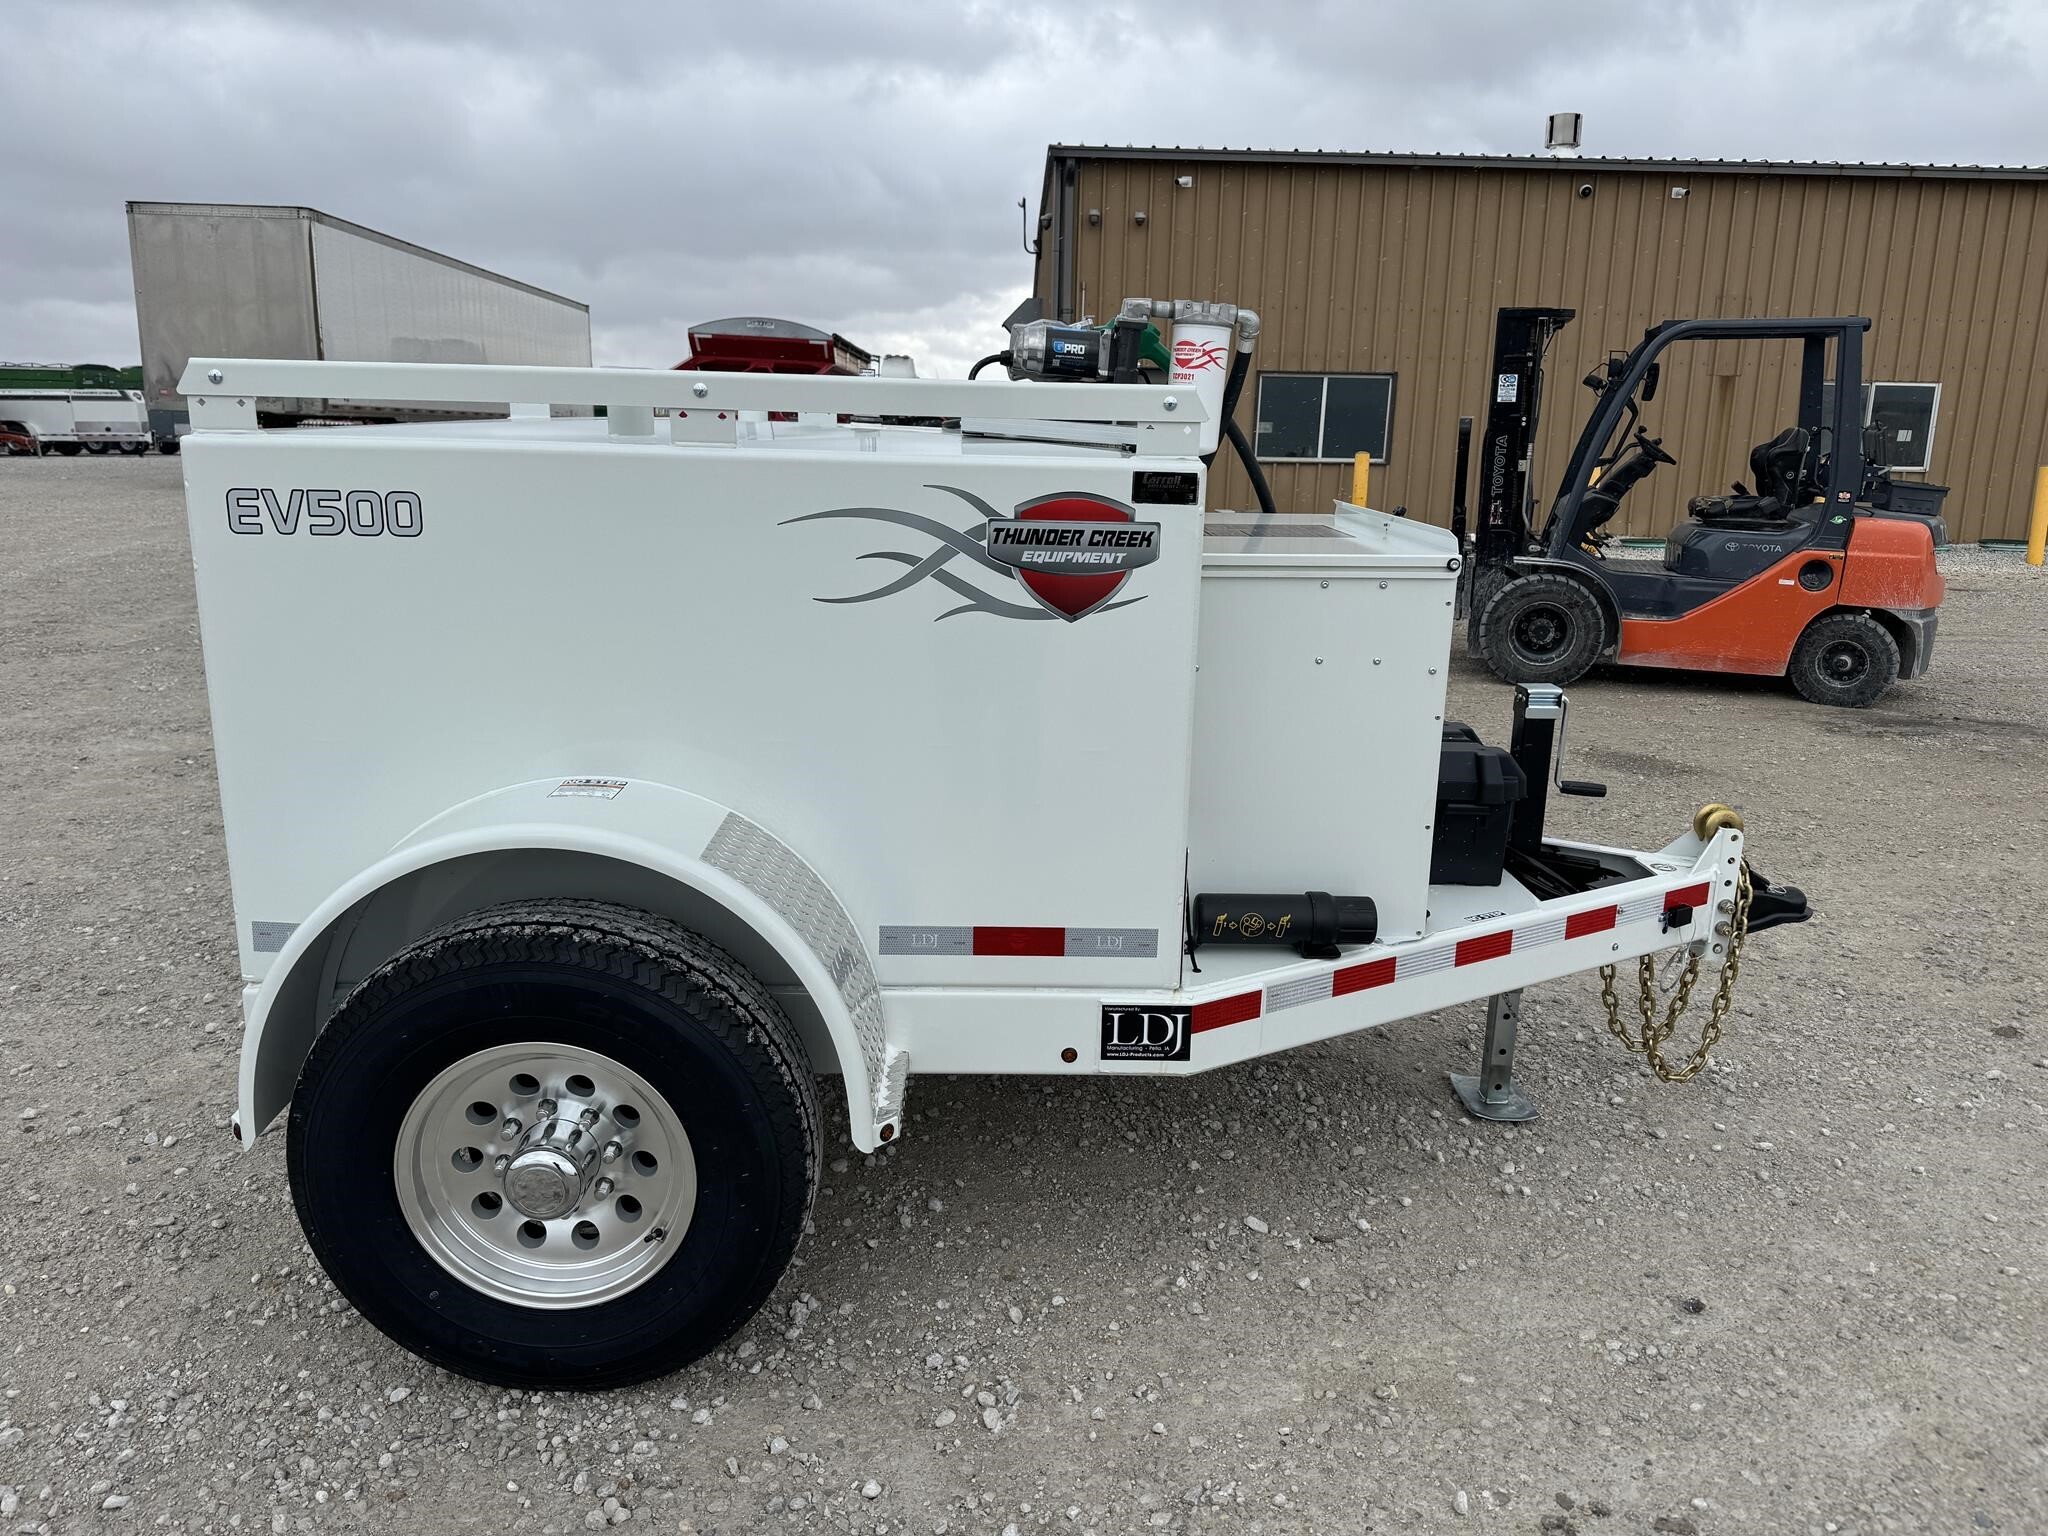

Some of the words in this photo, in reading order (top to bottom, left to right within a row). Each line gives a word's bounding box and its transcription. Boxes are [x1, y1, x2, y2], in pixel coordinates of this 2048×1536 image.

[1491, 435, 1508, 496] TOYOTA
[226, 488, 423, 537] EV500
[992, 527, 1086, 546] THUNDER
[1088, 530, 1155, 548] CREEK
[1742, 543, 1782, 552] TOYOTA
[1021, 550, 1127, 564] EQUIPMENT
[912, 934, 938, 948] LDJ
[1097, 935, 1123, 950] LDJ
[1107, 1012, 1190, 1057] LDJ
